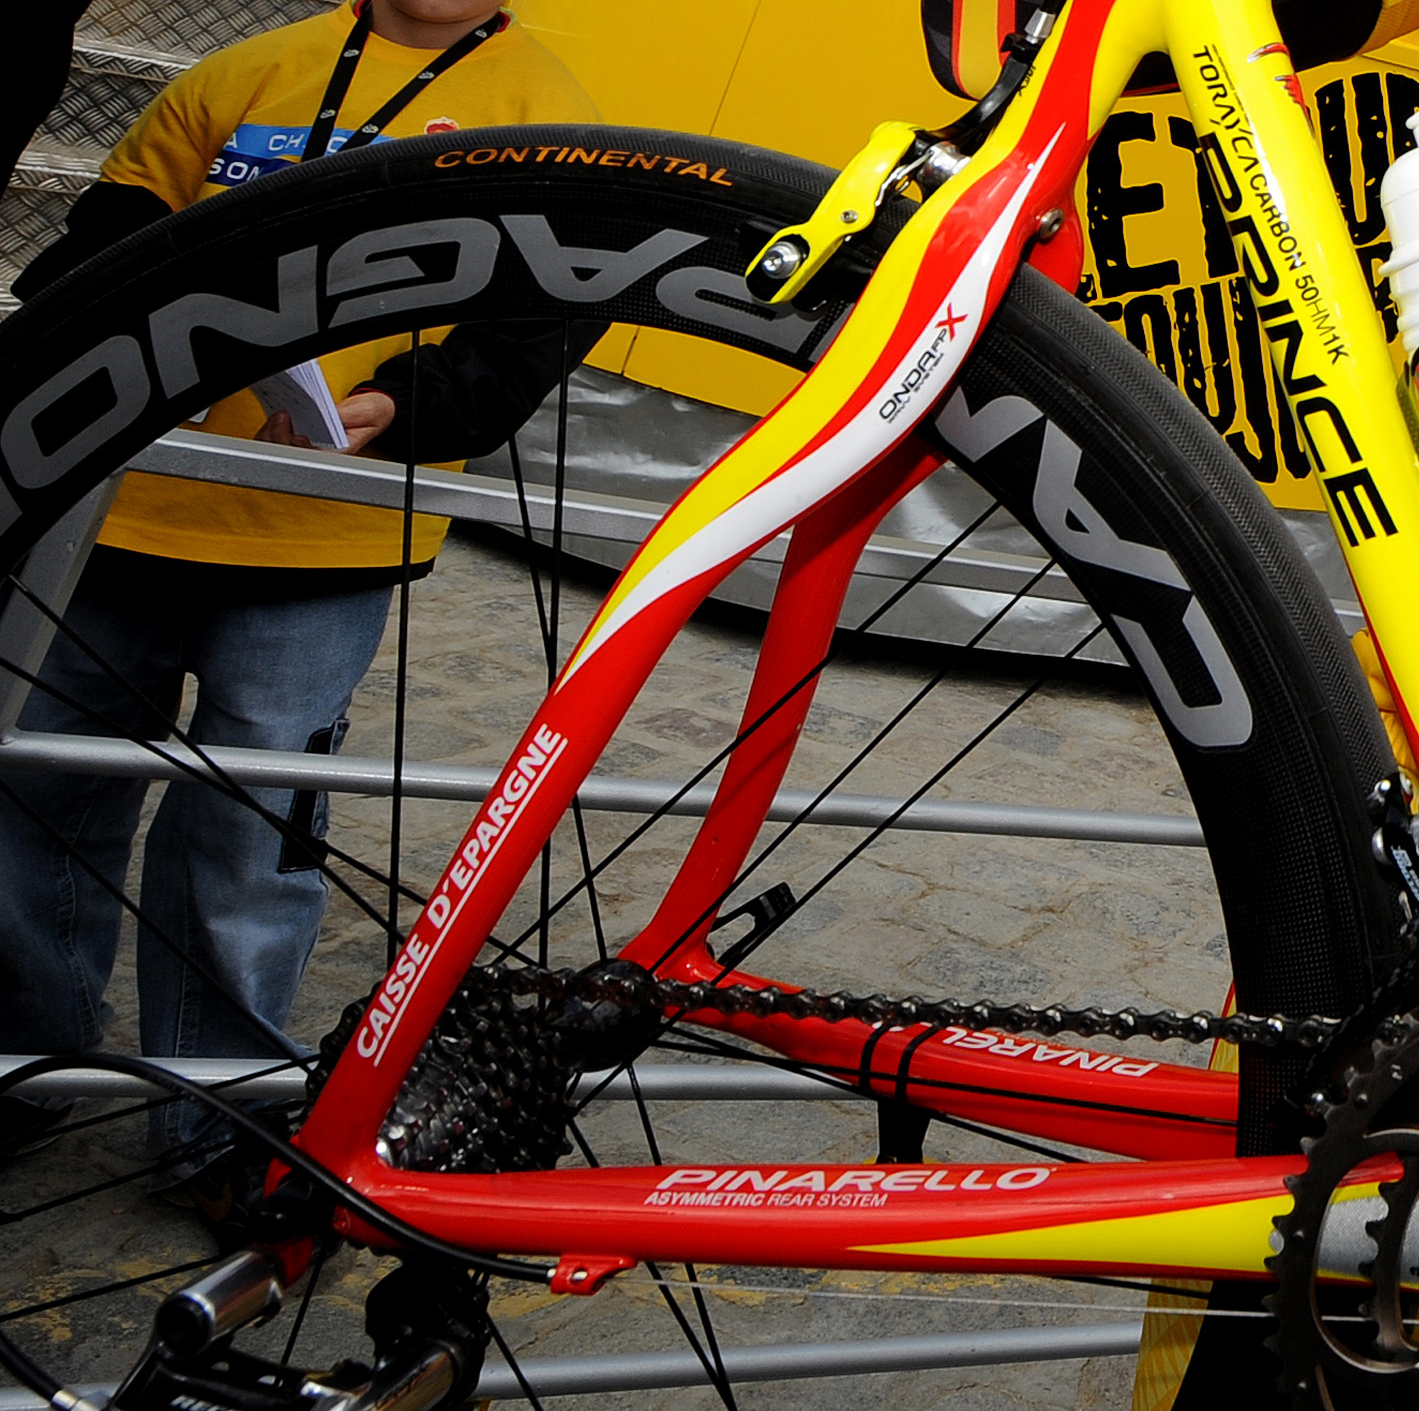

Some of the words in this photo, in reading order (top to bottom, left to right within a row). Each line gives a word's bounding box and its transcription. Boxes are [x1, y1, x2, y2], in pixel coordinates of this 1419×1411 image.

[434, 145, 734, 187] CONTINENTAL
[1201, 130, 1399, 548] PRINCE
[355, 933, 430, 1060] CAISSE
[426, 722, 563, 931] D'EPARGNE
[643, 1191, 764, 1207] ASYMMETRIC
[766, 1191, 815, 1207] REAR
[816, 1191, 889, 1207] SYSTEM
[655, 1166, 1052, 1192] PINARELLO
